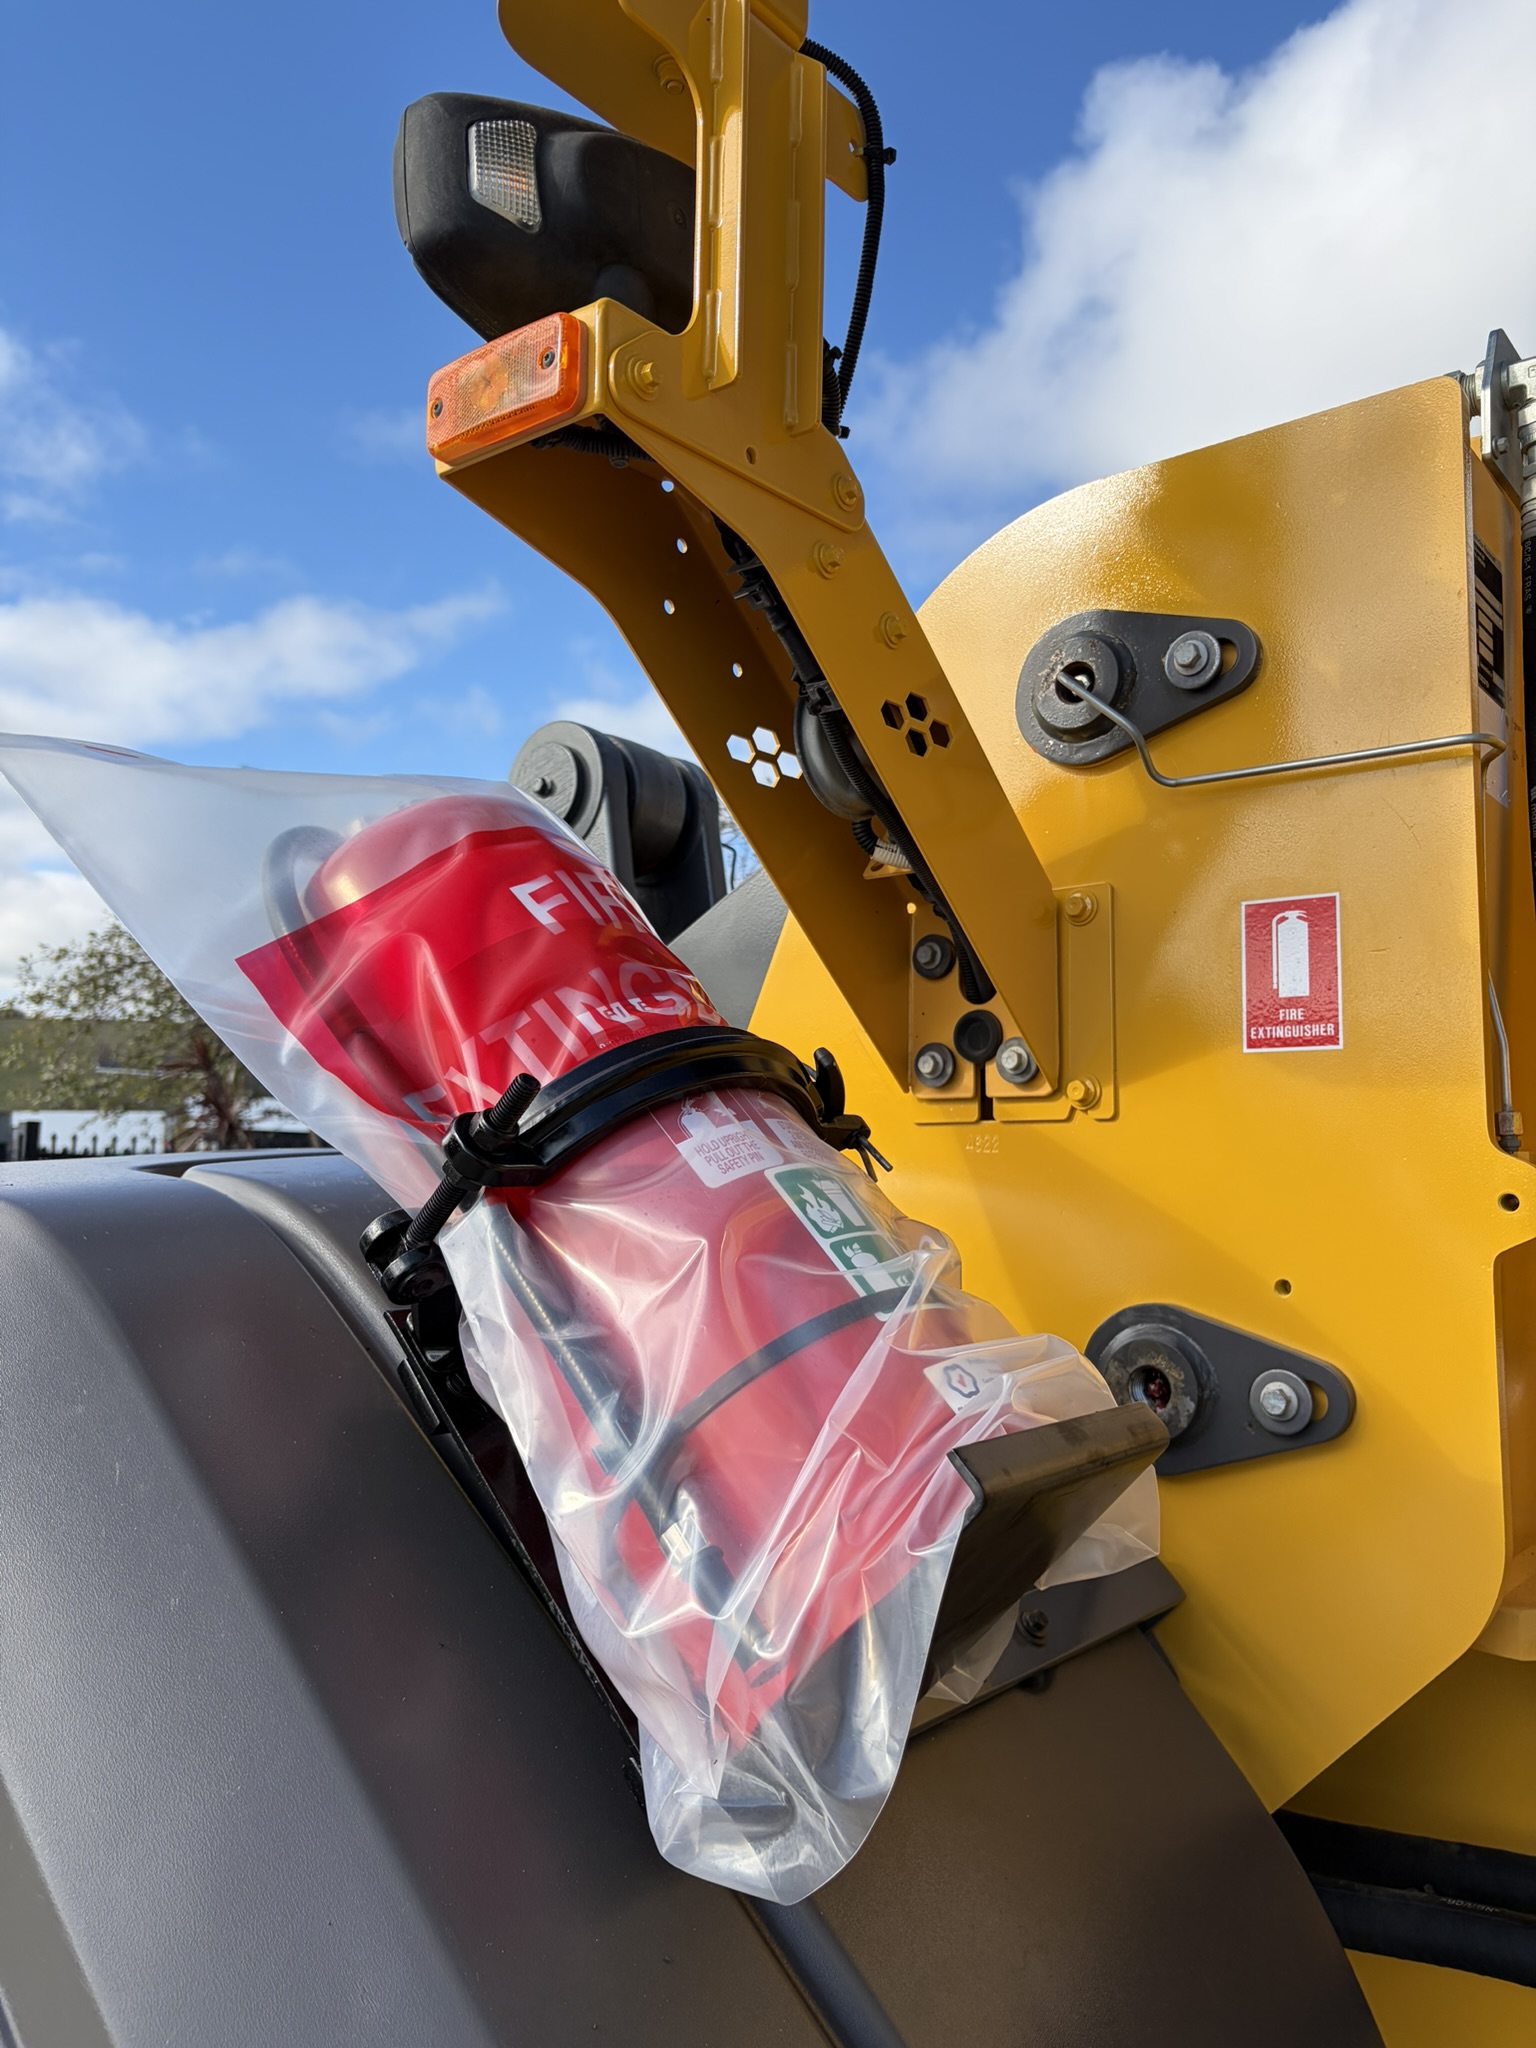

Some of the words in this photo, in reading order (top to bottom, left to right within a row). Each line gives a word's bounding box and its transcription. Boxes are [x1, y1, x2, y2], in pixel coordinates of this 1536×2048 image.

[1524, 575, 1532, 602] FRAS
[509, 868, 648, 935] FIR
[1279, 1008, 1305, 1020] FIRE
[1250, 1023, 1335, 1039] EXTINGUISHER
[693, 1139, 720, 1157] HOLD
[704, 1150, 729, 1167] PULL
[725, 1143, 745, 1158] OUT
[741, 1140, 761, 1152] THE
[717, 1154, 750, 1175] SAFETY
[747, 1150, 765, 1163] PIN
